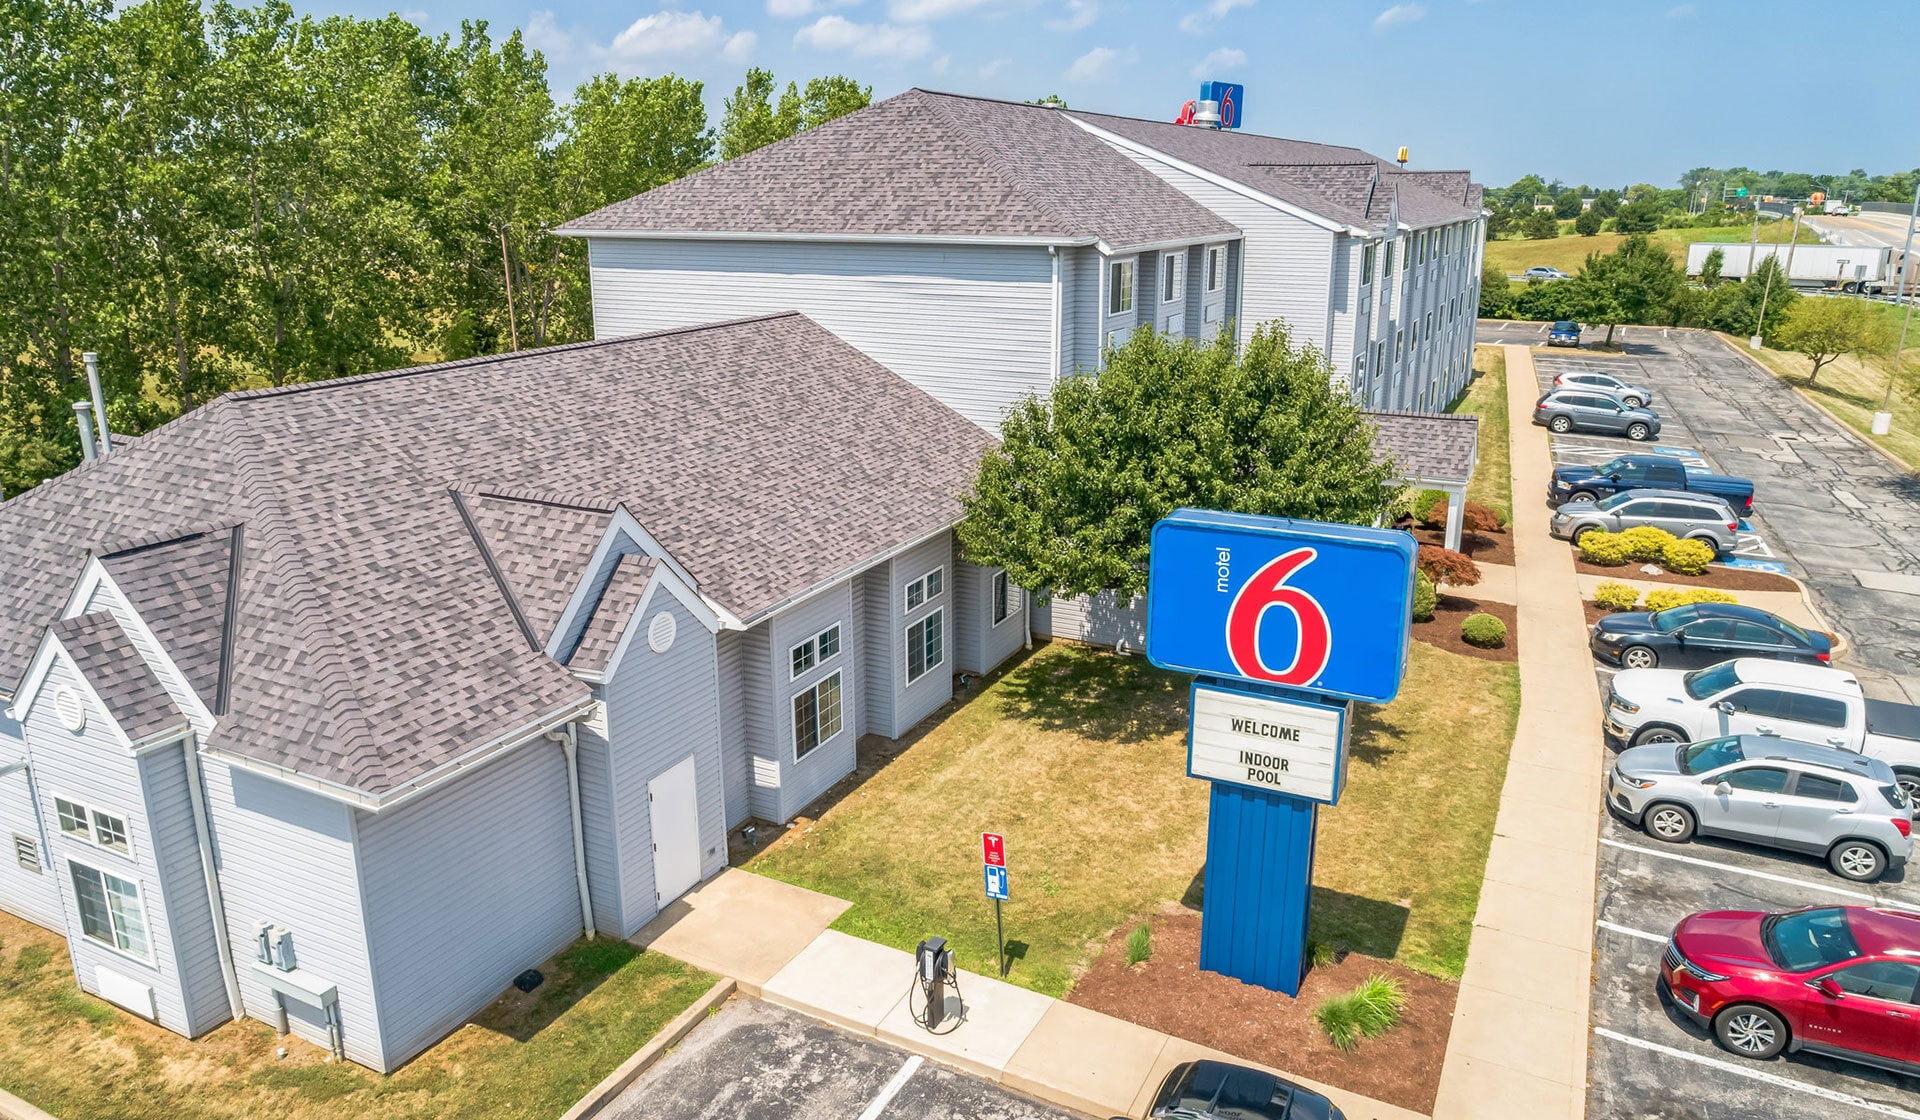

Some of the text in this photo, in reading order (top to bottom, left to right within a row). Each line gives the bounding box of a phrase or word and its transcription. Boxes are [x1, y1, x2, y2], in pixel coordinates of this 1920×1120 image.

[1215, 547, 1332, 686] motel 6
[1231, 718, 1300, 742] WELCOME
[1239, 750, 1289, 772] INDOOR
[1247, 767, 1281, 785] POOL
